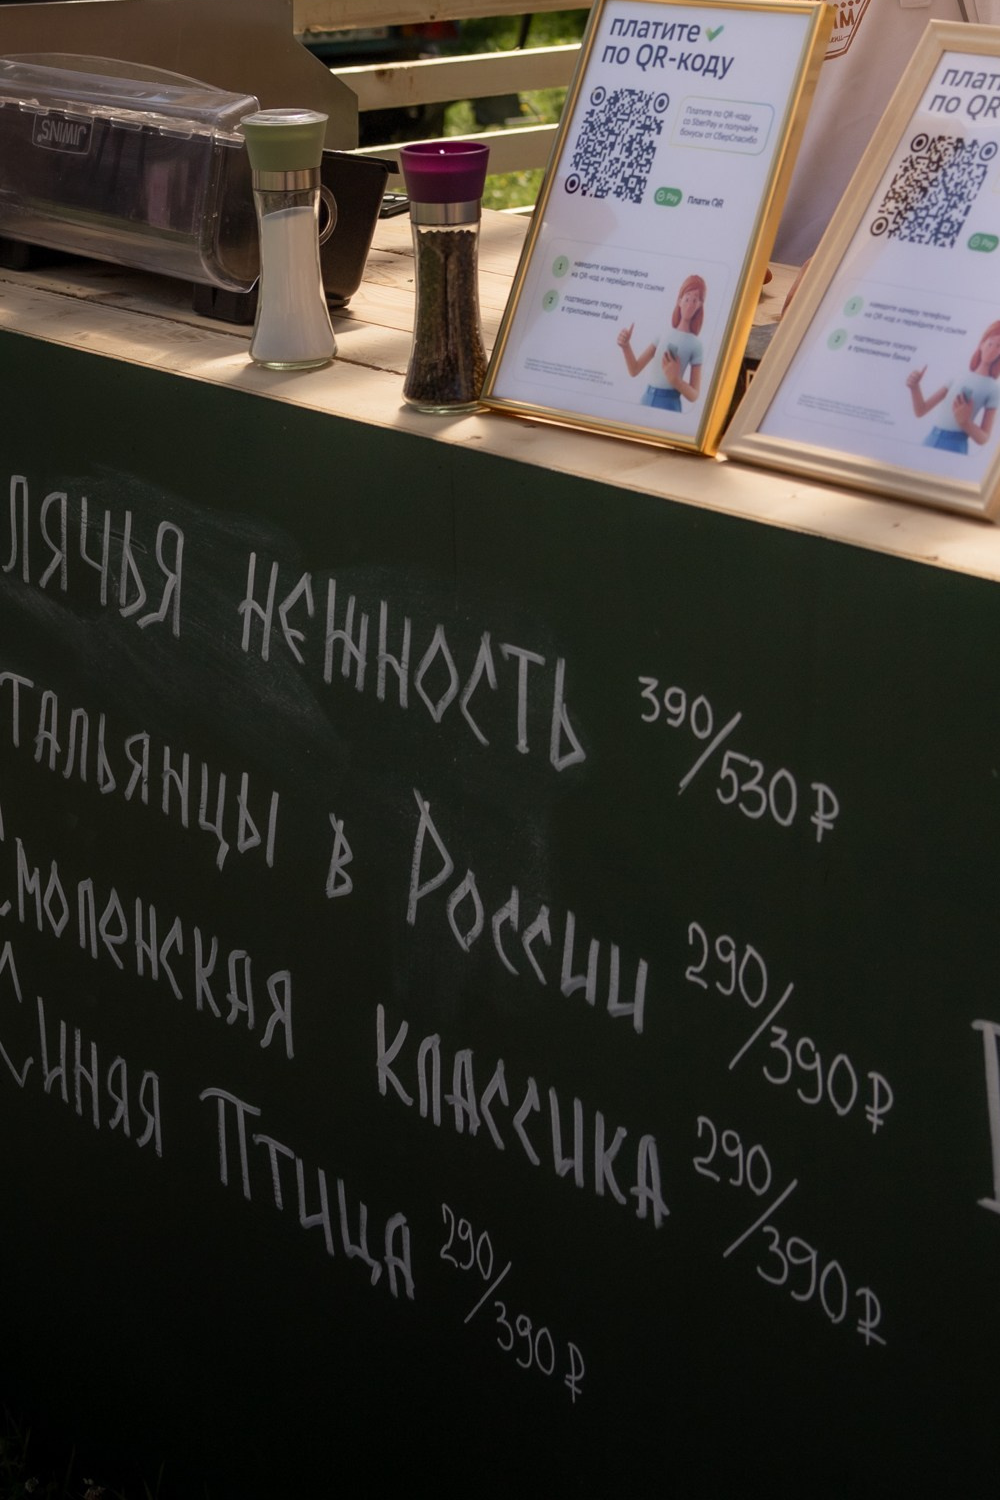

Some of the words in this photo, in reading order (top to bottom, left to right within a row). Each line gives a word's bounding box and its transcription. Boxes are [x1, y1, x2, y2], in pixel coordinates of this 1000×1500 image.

[601, 45, 631, 65] по
[635, 43, 735, 80] QR-коду
[610, 18, 701, 43] платите
[928, 94, 962, 114] по
[2, 474, 184, 638] ЛЯЧЬЯ
[0, 835, 295, 1060] МОЛЕНСКАЯ
[376, 1003, 670, 1229] КЛАССИКА
[200, 1087, 416, 1301] ПТИЦА
